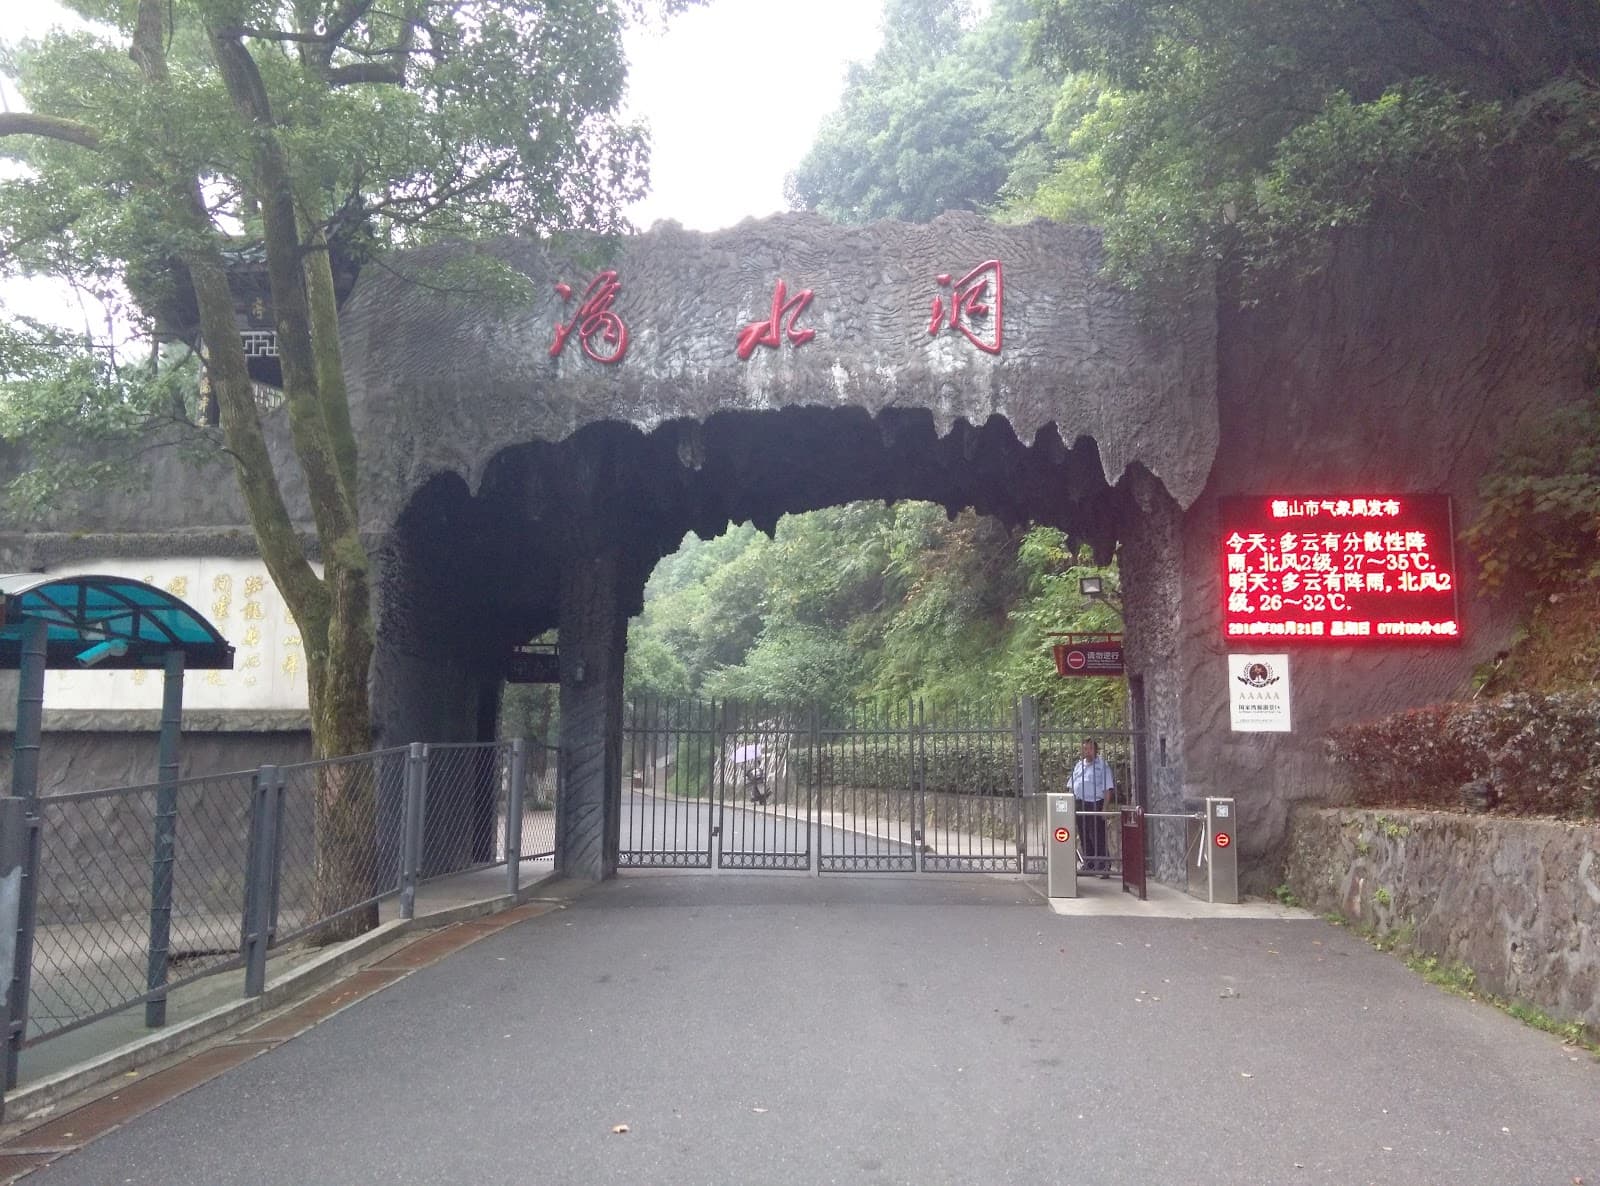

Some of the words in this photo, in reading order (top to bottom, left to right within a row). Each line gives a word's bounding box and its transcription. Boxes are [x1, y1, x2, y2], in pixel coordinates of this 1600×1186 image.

[548, 259, 1003, 365] 滴水洞
[1272, 499, 1401, 518] 韶山市气象局发布
[1331, 621, 1369, 635] 星期日
